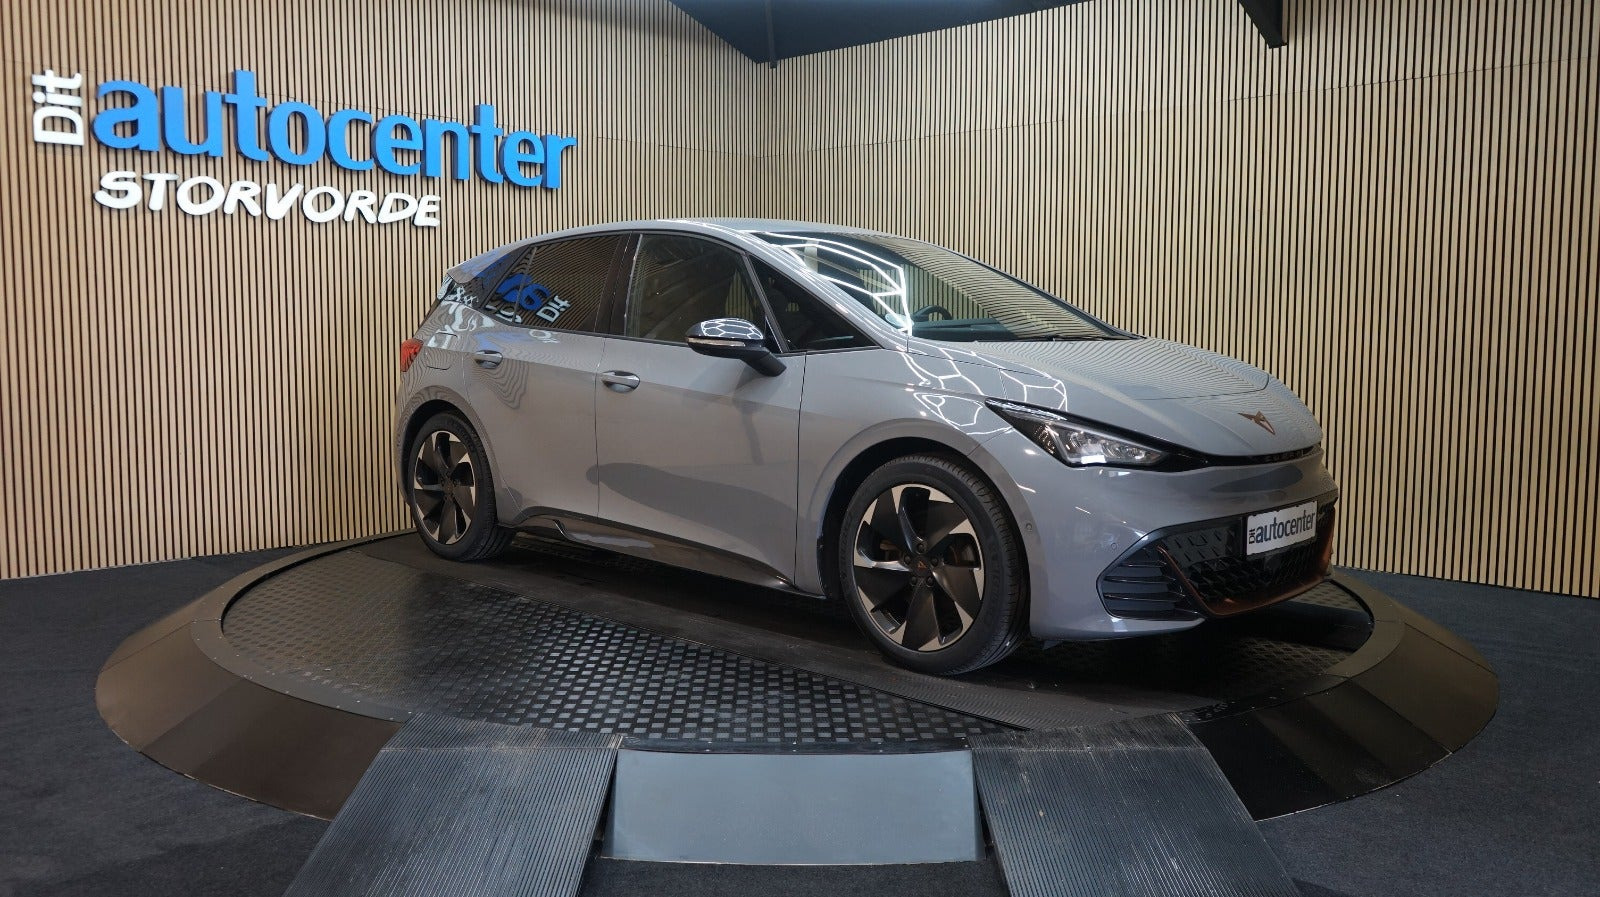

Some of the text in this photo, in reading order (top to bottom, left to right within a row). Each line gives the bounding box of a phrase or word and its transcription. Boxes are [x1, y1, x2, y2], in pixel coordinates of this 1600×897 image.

[32, 69, 577, 189] Dit autocenter
[94, 170, 442, 228] STORVORDE
[1255, 510, 1315, 543] autocenter
